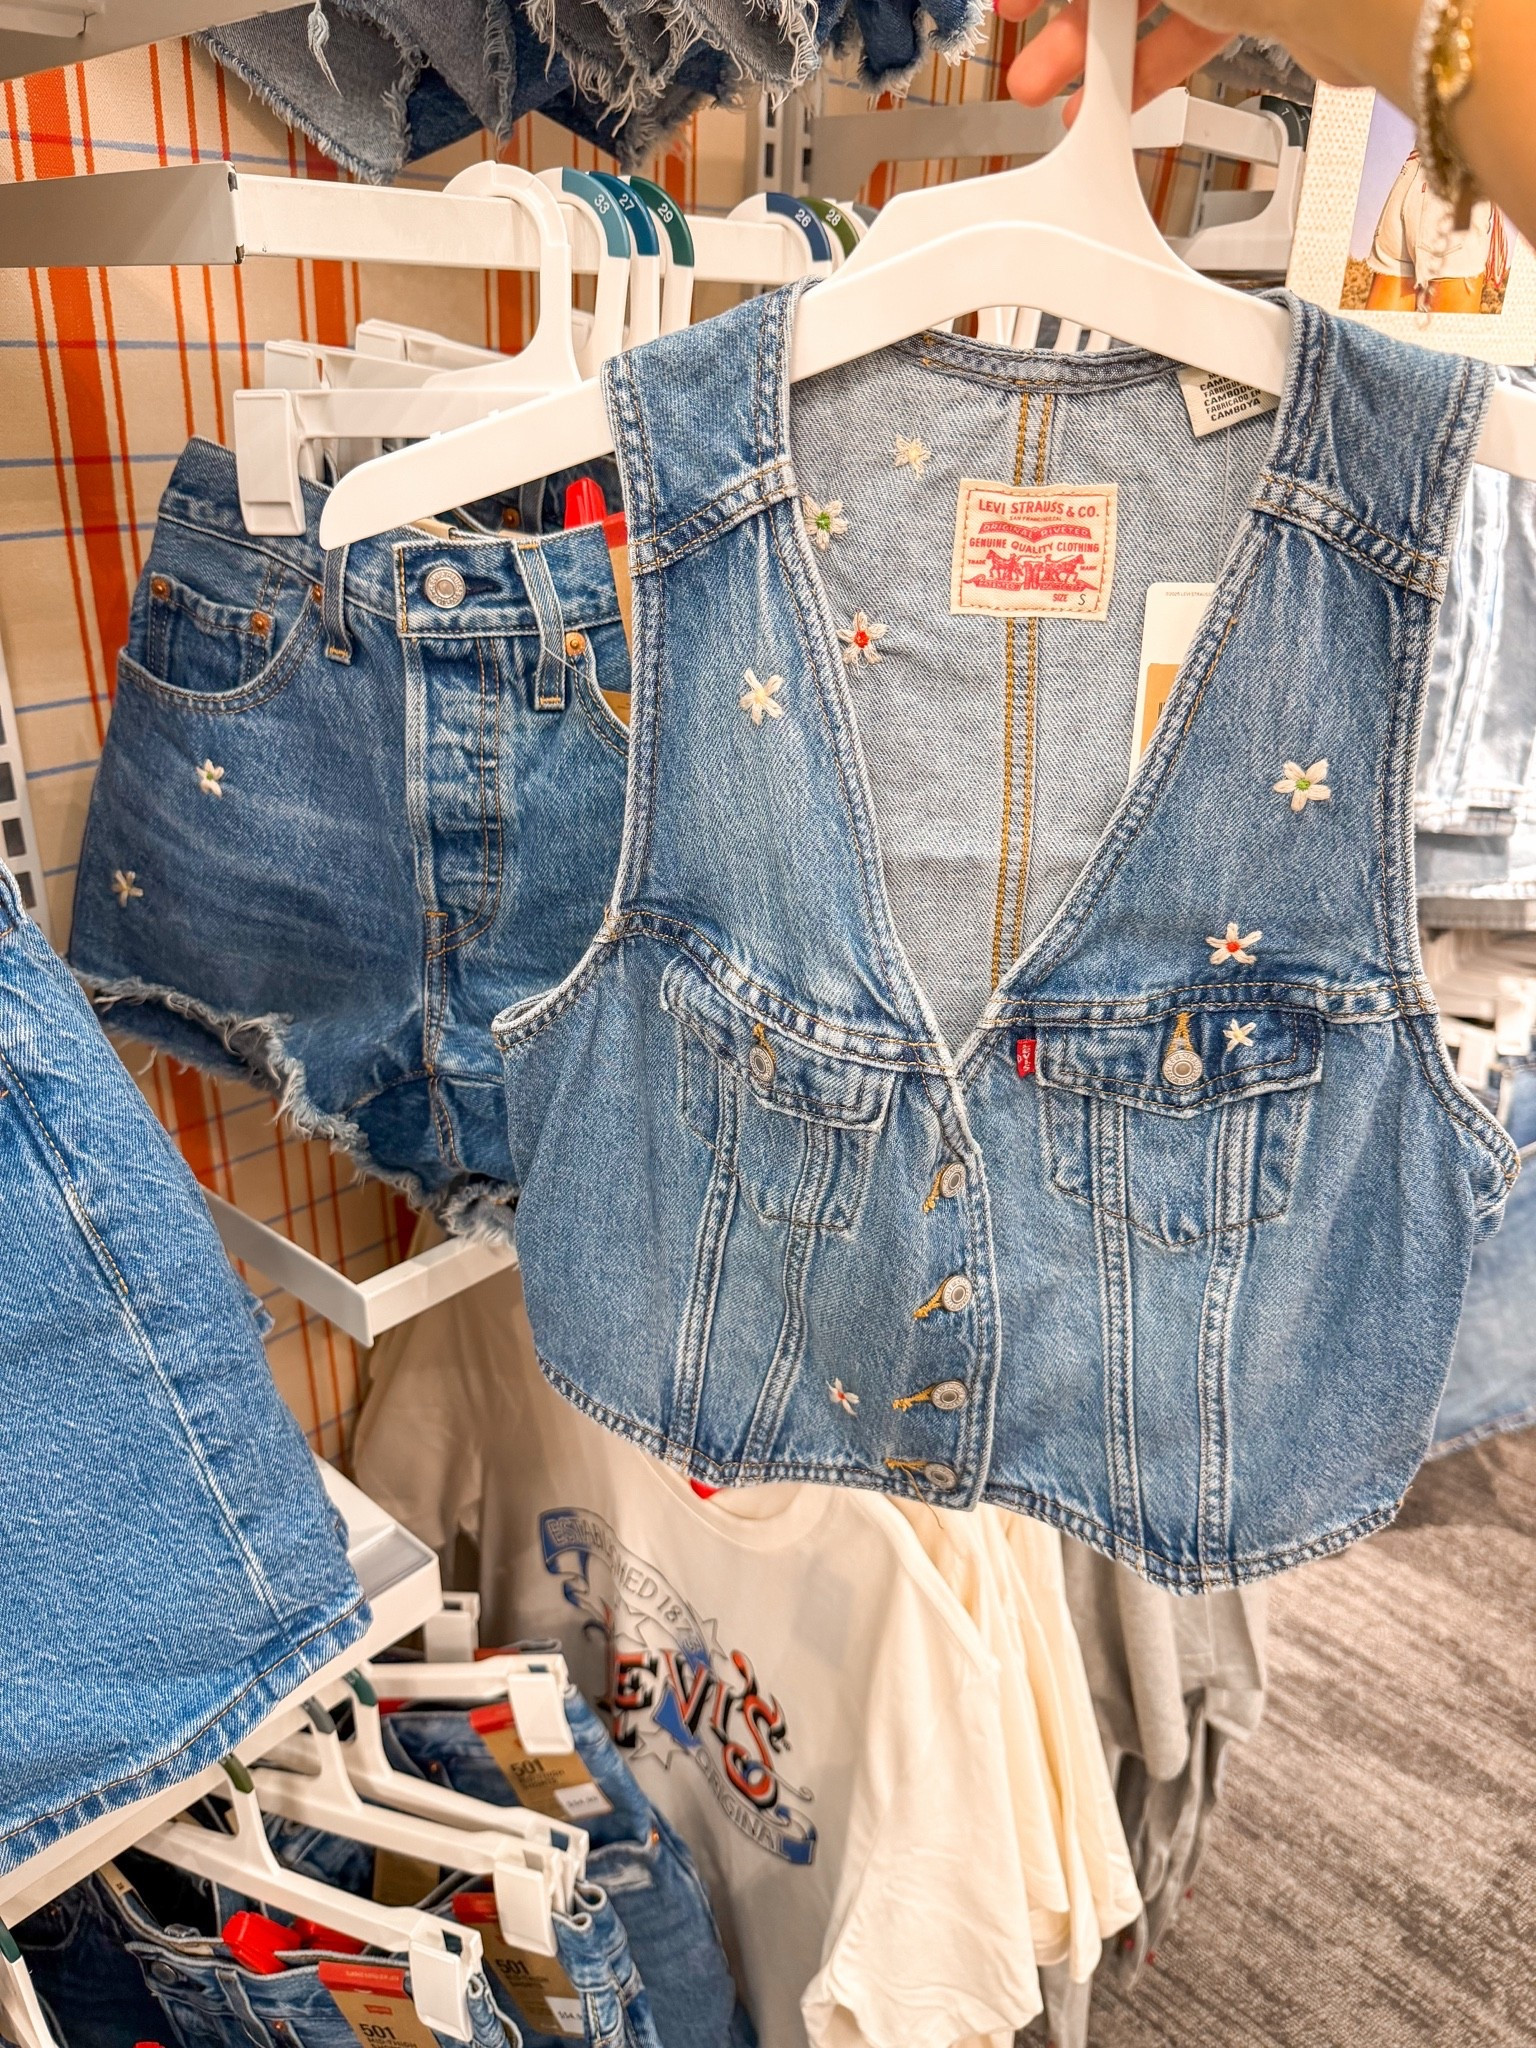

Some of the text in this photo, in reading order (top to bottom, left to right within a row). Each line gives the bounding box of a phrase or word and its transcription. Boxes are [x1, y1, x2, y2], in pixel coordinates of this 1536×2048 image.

[594, 194, 610, 215] 33
[619, 193, 635, 211] 27
[657, 203, 674, 223] 29
[794, 208, 811, 228] 26
[825, 208, 841, 227] 28
[1206, 393, 1249, 414] FABRICADO
[1211, 398, 1261, 421] CAMBOYA
[978, 499, 1100, 518] LEVI STRAUSS & CO.
[983, 522, 1089, 540] ORIGINAL RIVETED
[969, 537, 1100, 555] GENUINE QUALITY CLOTHING
[1052, 593, 1086, 606] SIZE S
[510, 1758, 545, 1777] 501
[495, 1958, 530, 1975] 501
[359, 2022, 397, 2040] 501
